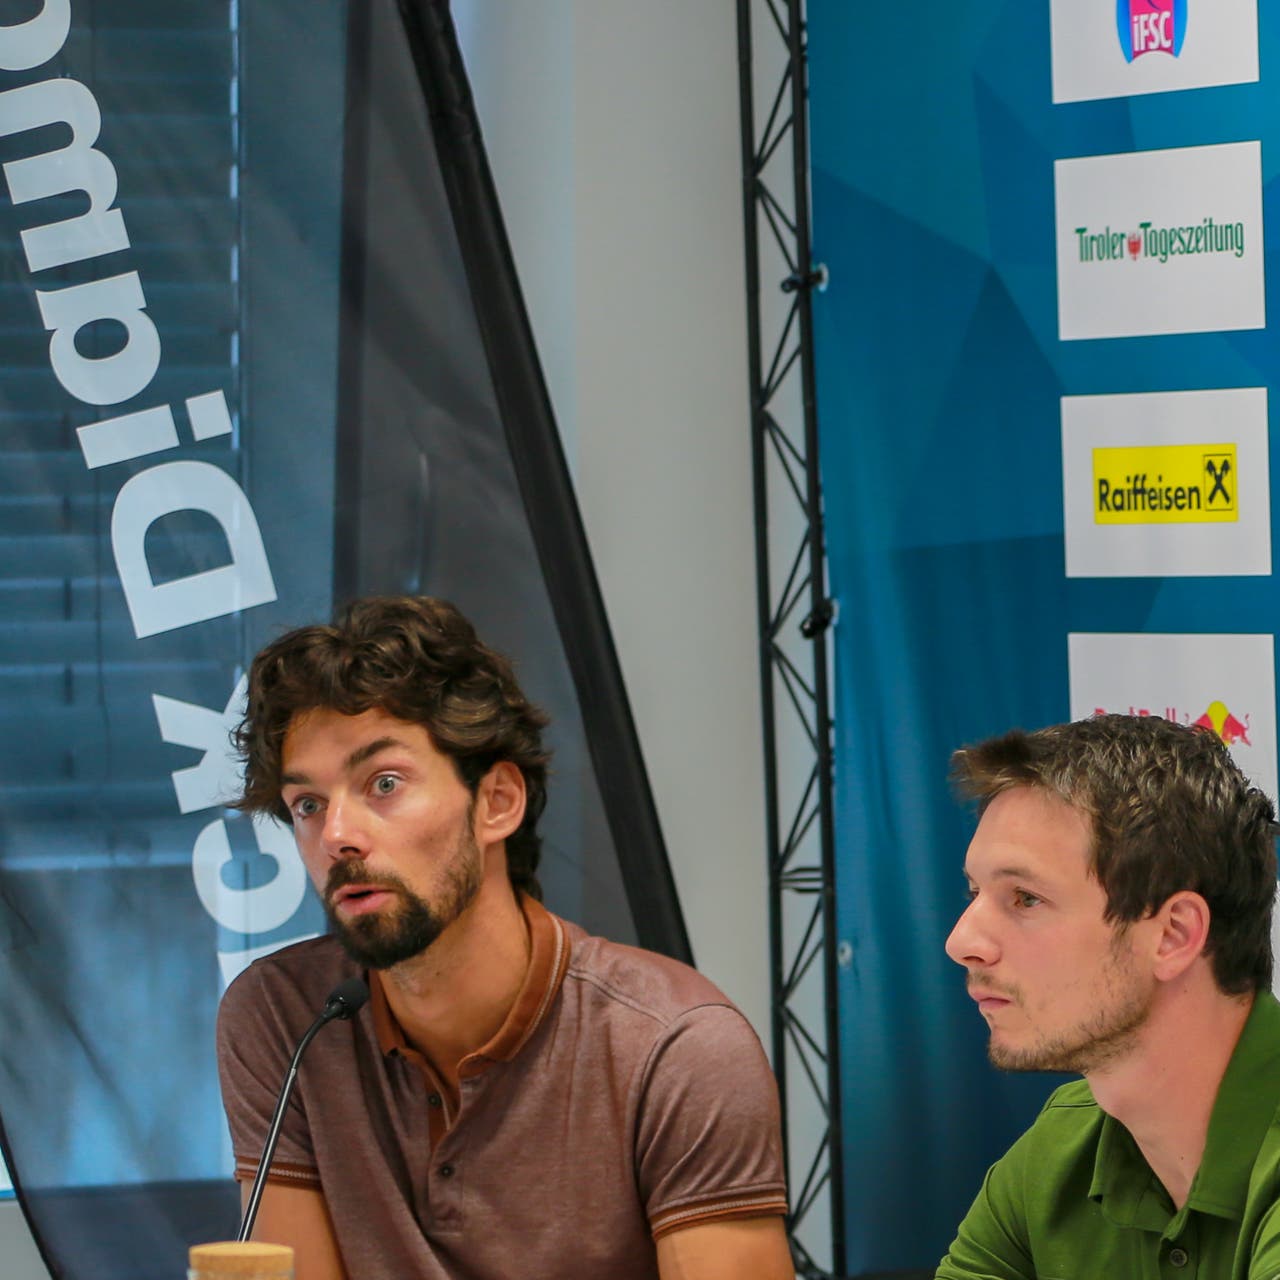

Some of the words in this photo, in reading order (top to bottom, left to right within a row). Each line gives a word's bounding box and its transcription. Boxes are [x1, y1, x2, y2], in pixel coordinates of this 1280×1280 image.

[1075, 226, 1126, 262] Tiroler
[1140, 218, 1244, 263] Tageszeitung
[1099, 473, 1200, 513] Raiffeisen
